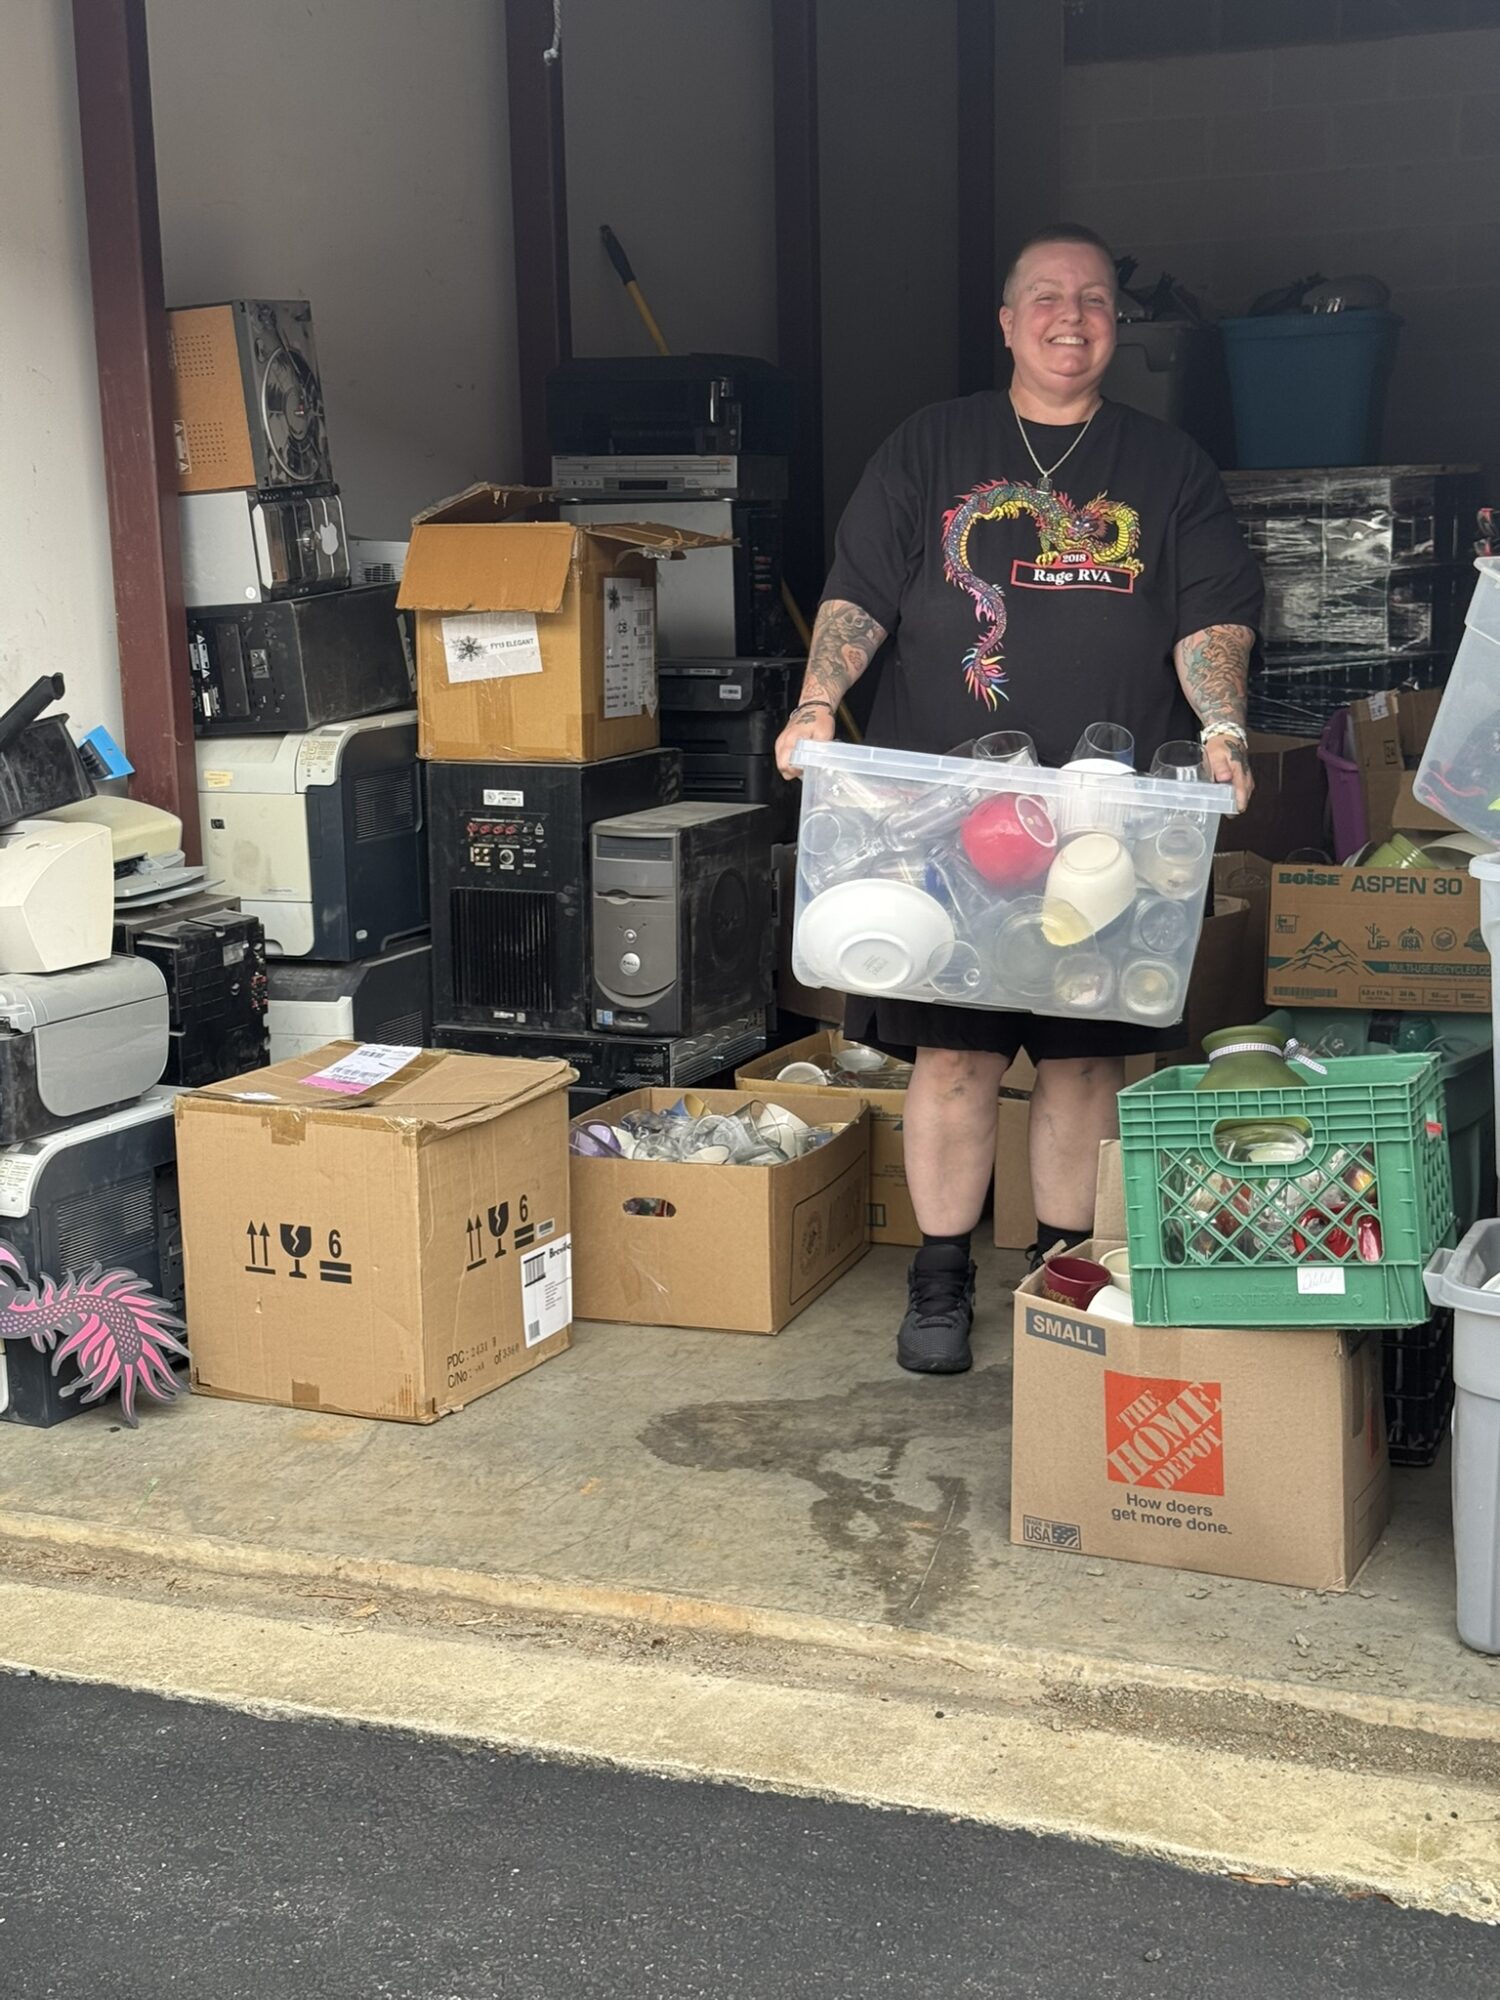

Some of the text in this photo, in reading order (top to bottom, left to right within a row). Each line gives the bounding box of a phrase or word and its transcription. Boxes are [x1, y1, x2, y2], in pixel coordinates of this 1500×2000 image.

[1062, 553, 1086, 563] 2018
[1033, 568, 1112, 585] Rage RVA
[506, 638, 534, 648] ELEGANT
[1351, 875, 1462, 895] ASPEN 30
[1401, 936, 1421, 950] USA
[1432, 964, 1477, 975] RECYCLED
[519, 1194, 529, 1222] 6
[328, 1229, 342, 1259] 6
[1032, 1314, 1098, 1349] SMALL
[1115, 1389, 1162, 1431] THE
[1107, 1381, 1222, 1484] HOME
[1152, 1425, 1222, 1489] DEPOT
[1126, 1492, 1213, 1517] How doers
[1027, 1525, 1050, 1542] USA
[1111, 1507, 1232, 1535] get more done.
